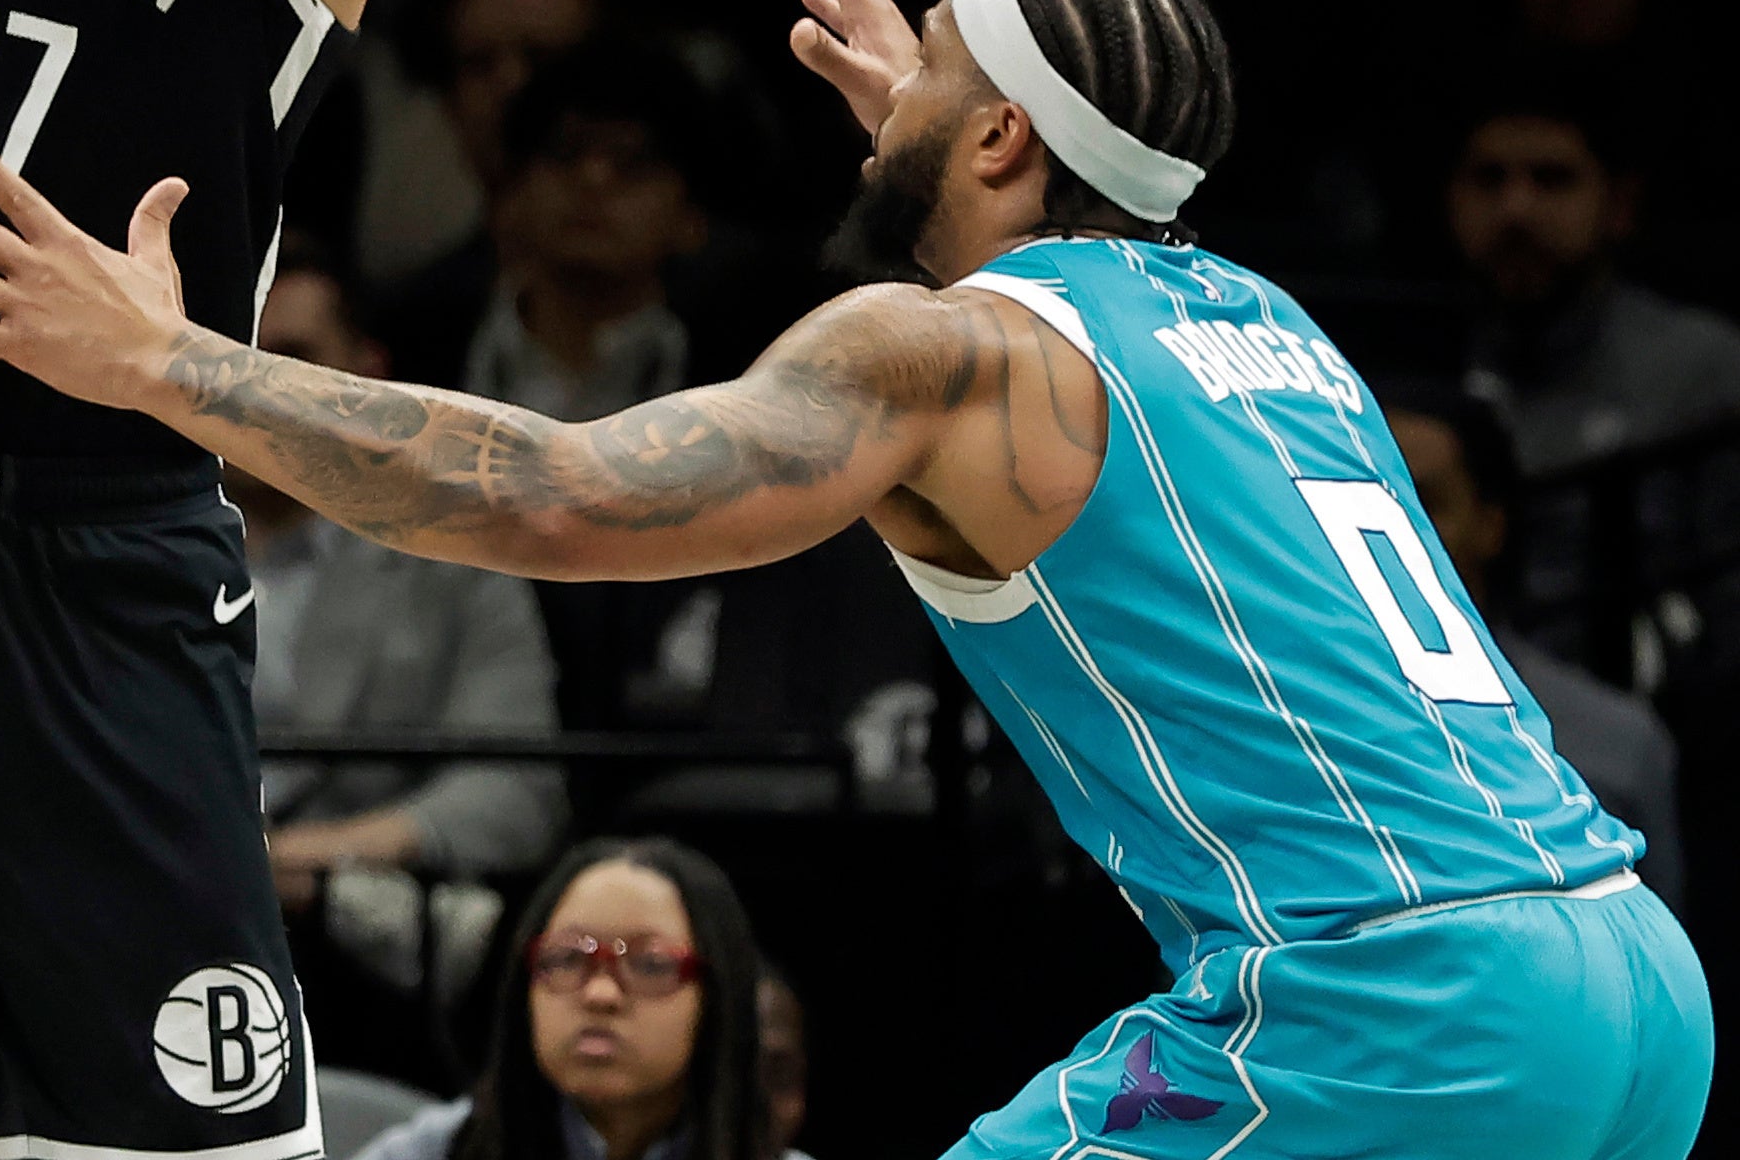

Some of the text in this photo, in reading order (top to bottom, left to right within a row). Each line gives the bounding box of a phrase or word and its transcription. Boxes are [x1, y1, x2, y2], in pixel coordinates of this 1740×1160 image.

[1153, 320, 1363, 415] BRIDGES
[1292, 477, 1517, 707] 0
[207, 986, 255, 1092] B
